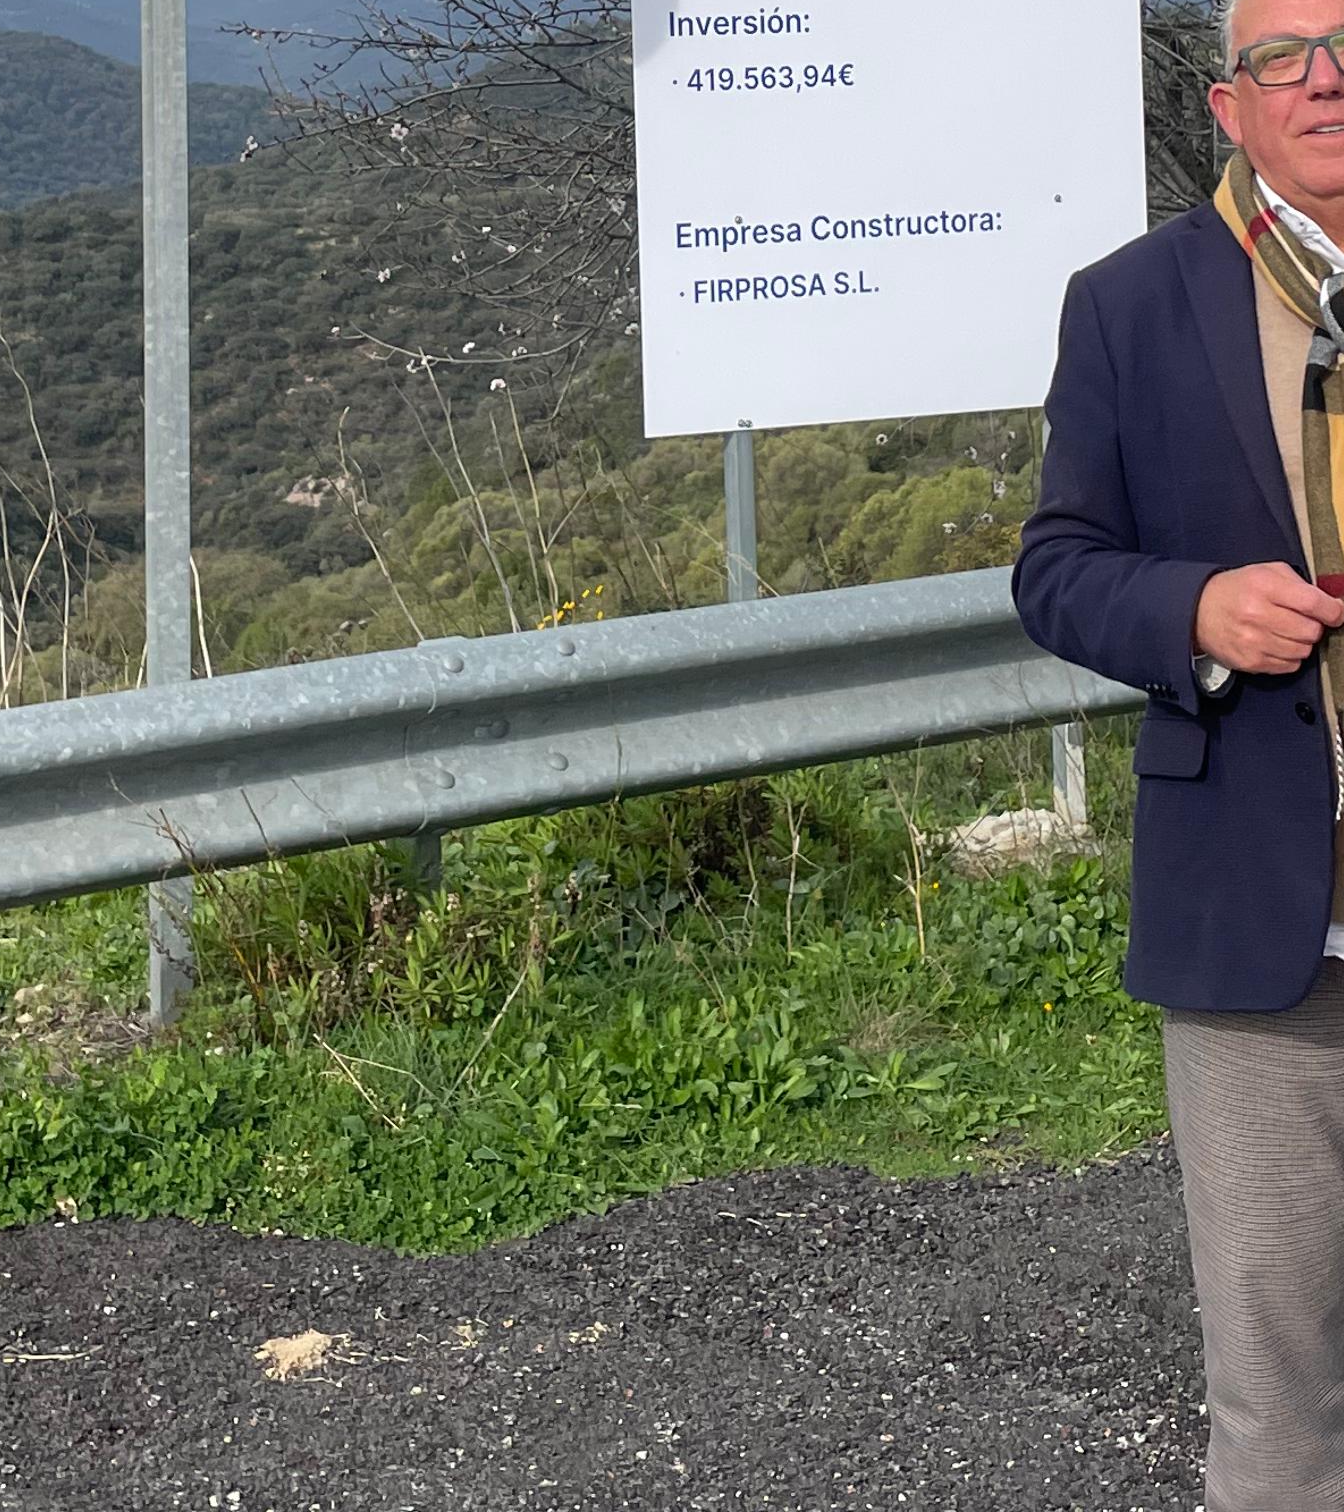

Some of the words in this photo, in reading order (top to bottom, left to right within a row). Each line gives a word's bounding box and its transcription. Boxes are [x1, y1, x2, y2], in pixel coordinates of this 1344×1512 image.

[669, 7, 811, 37] Inversión:
[687, 64, 854, 93] 419.563,94€
[676, 221, 802, 253] Empresa
[811, 210, 1003, 241] Constructora:
[694, 274, 826, 303] FIRPROSA
[834, 270, 880, 294] S.L.
